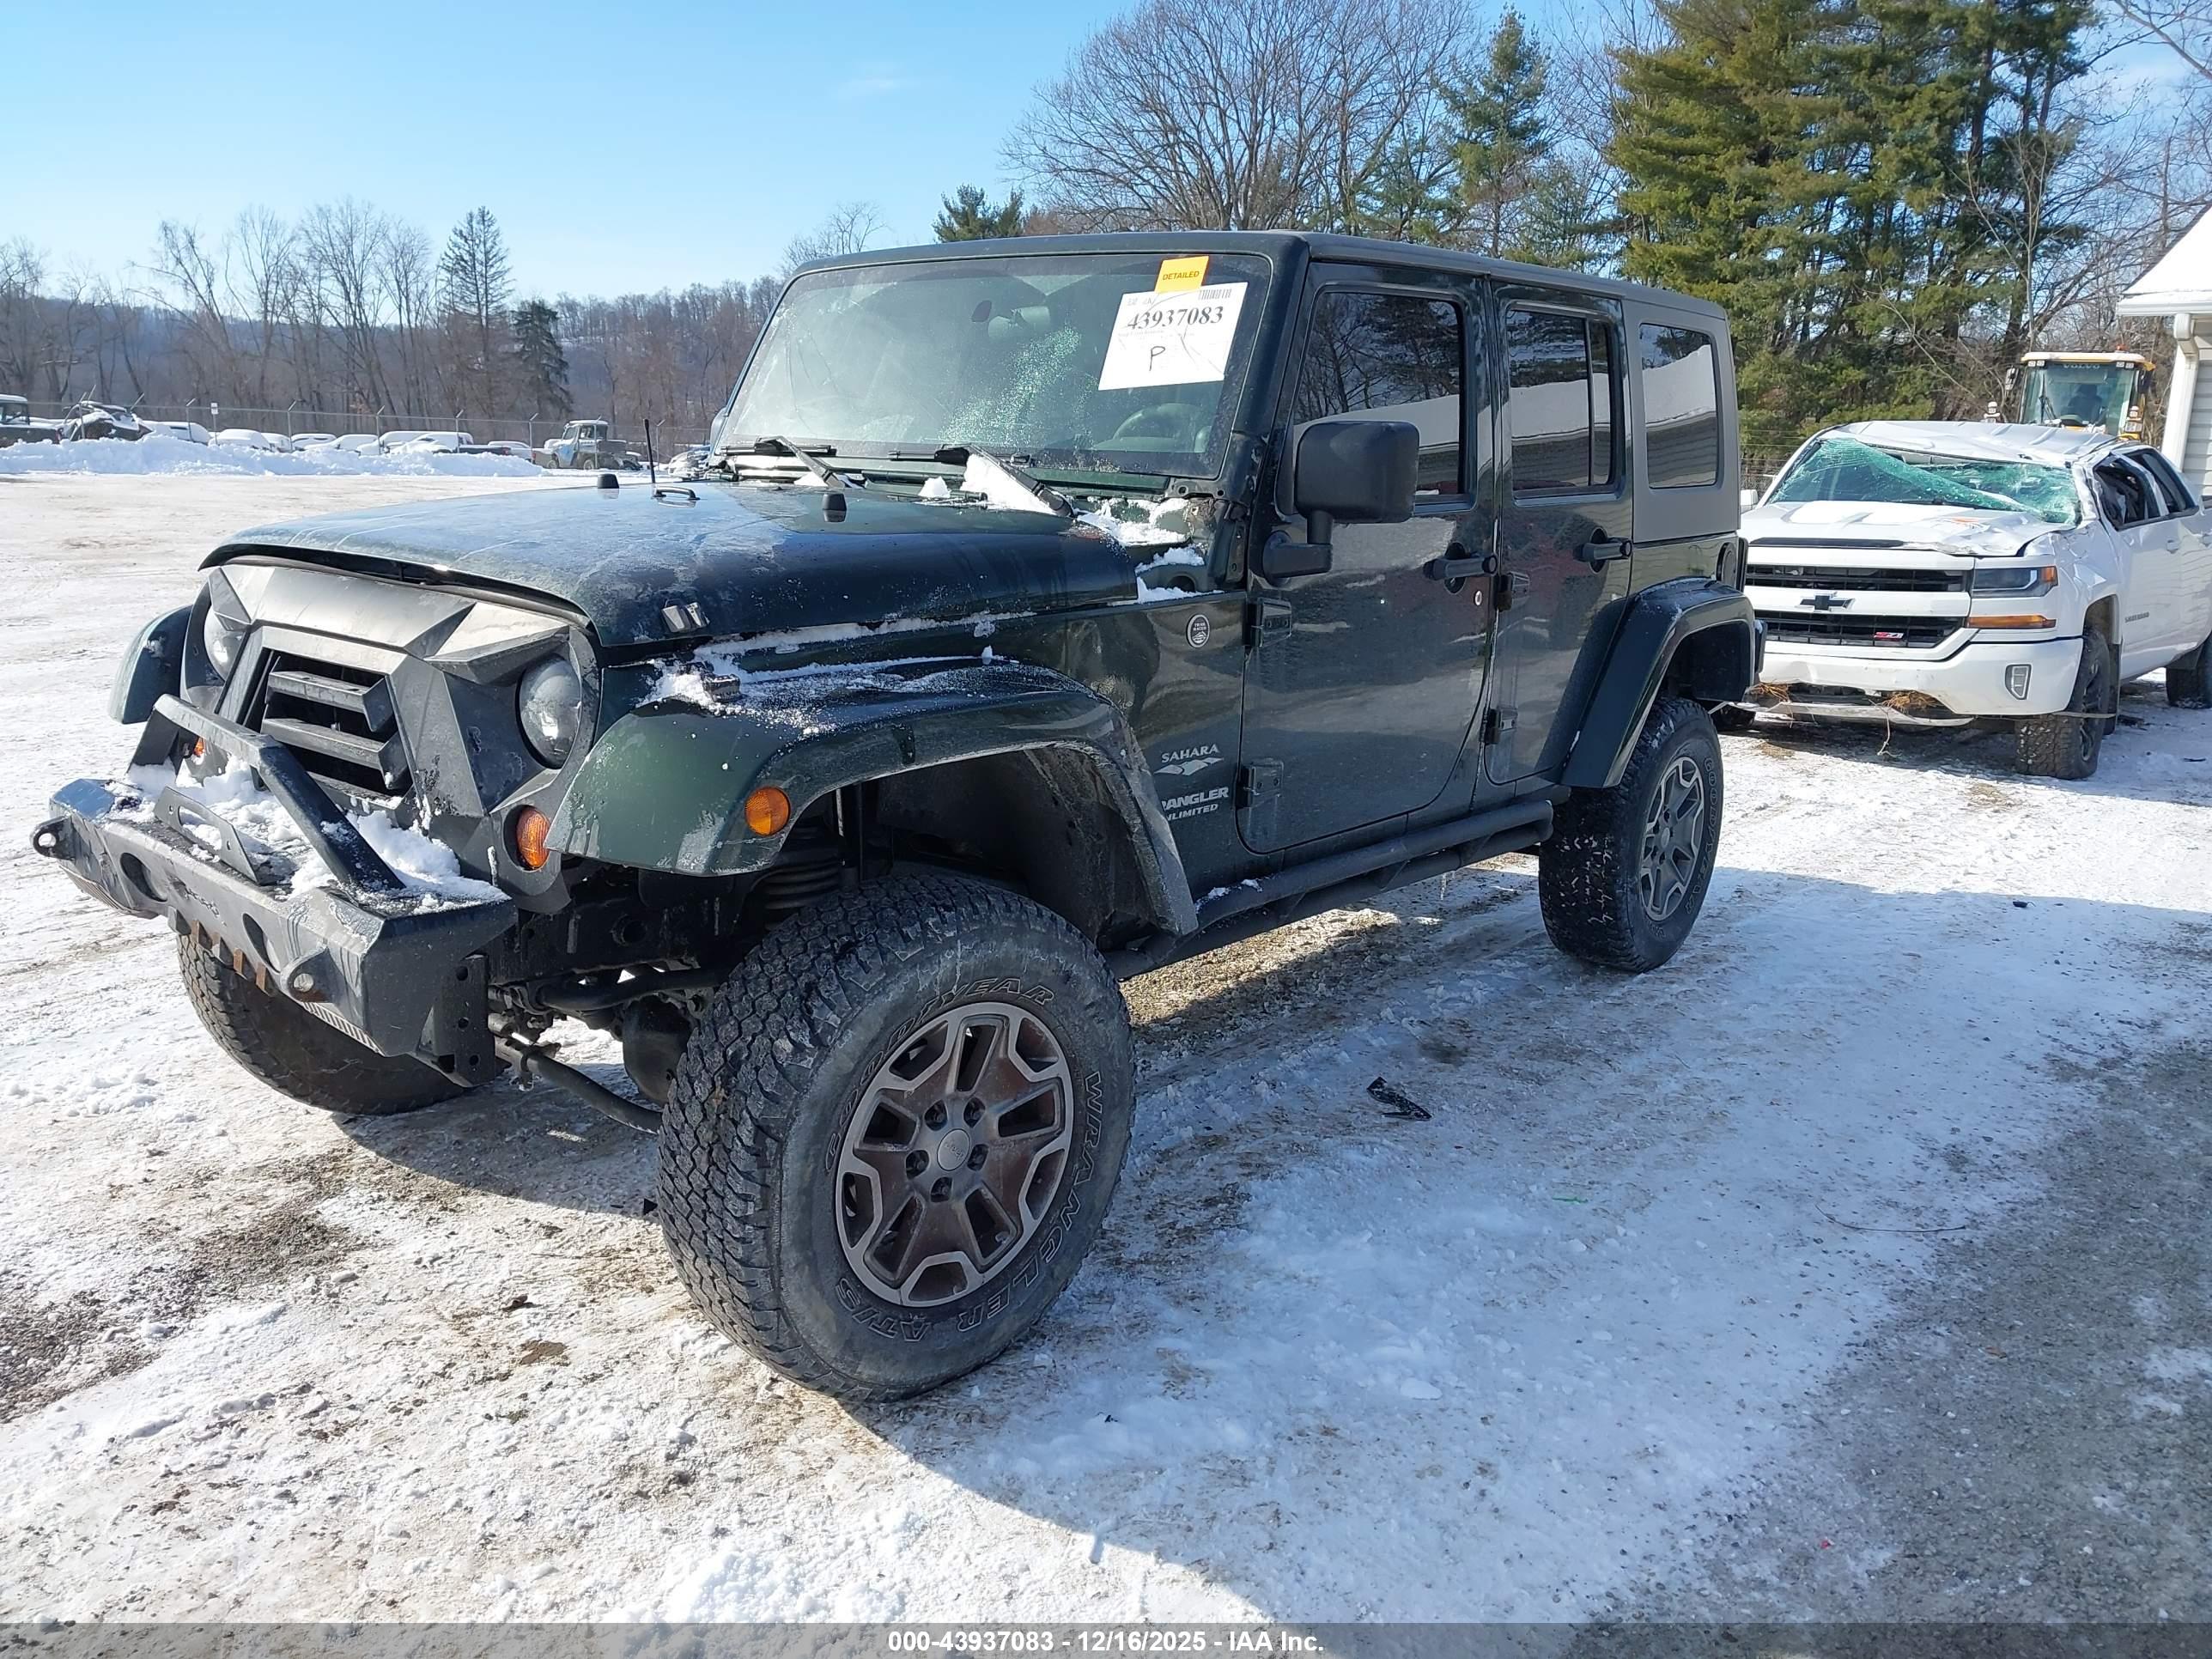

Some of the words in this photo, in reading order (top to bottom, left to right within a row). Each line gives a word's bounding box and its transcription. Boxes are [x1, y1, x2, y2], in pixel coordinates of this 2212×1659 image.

[1162, 270, 1200, 282] DETAILED
[1127, 306, 1224, 330] 43937083
[1149, 345, 1166, 372] P
[1161, 744, 1219, 763] SAHARA
[1161, 787, 1229, 811] RANGLER
[1166, 804, 1218, 822] NLIMITED
[957, 1071, 1103, 1332] WRANGLER
